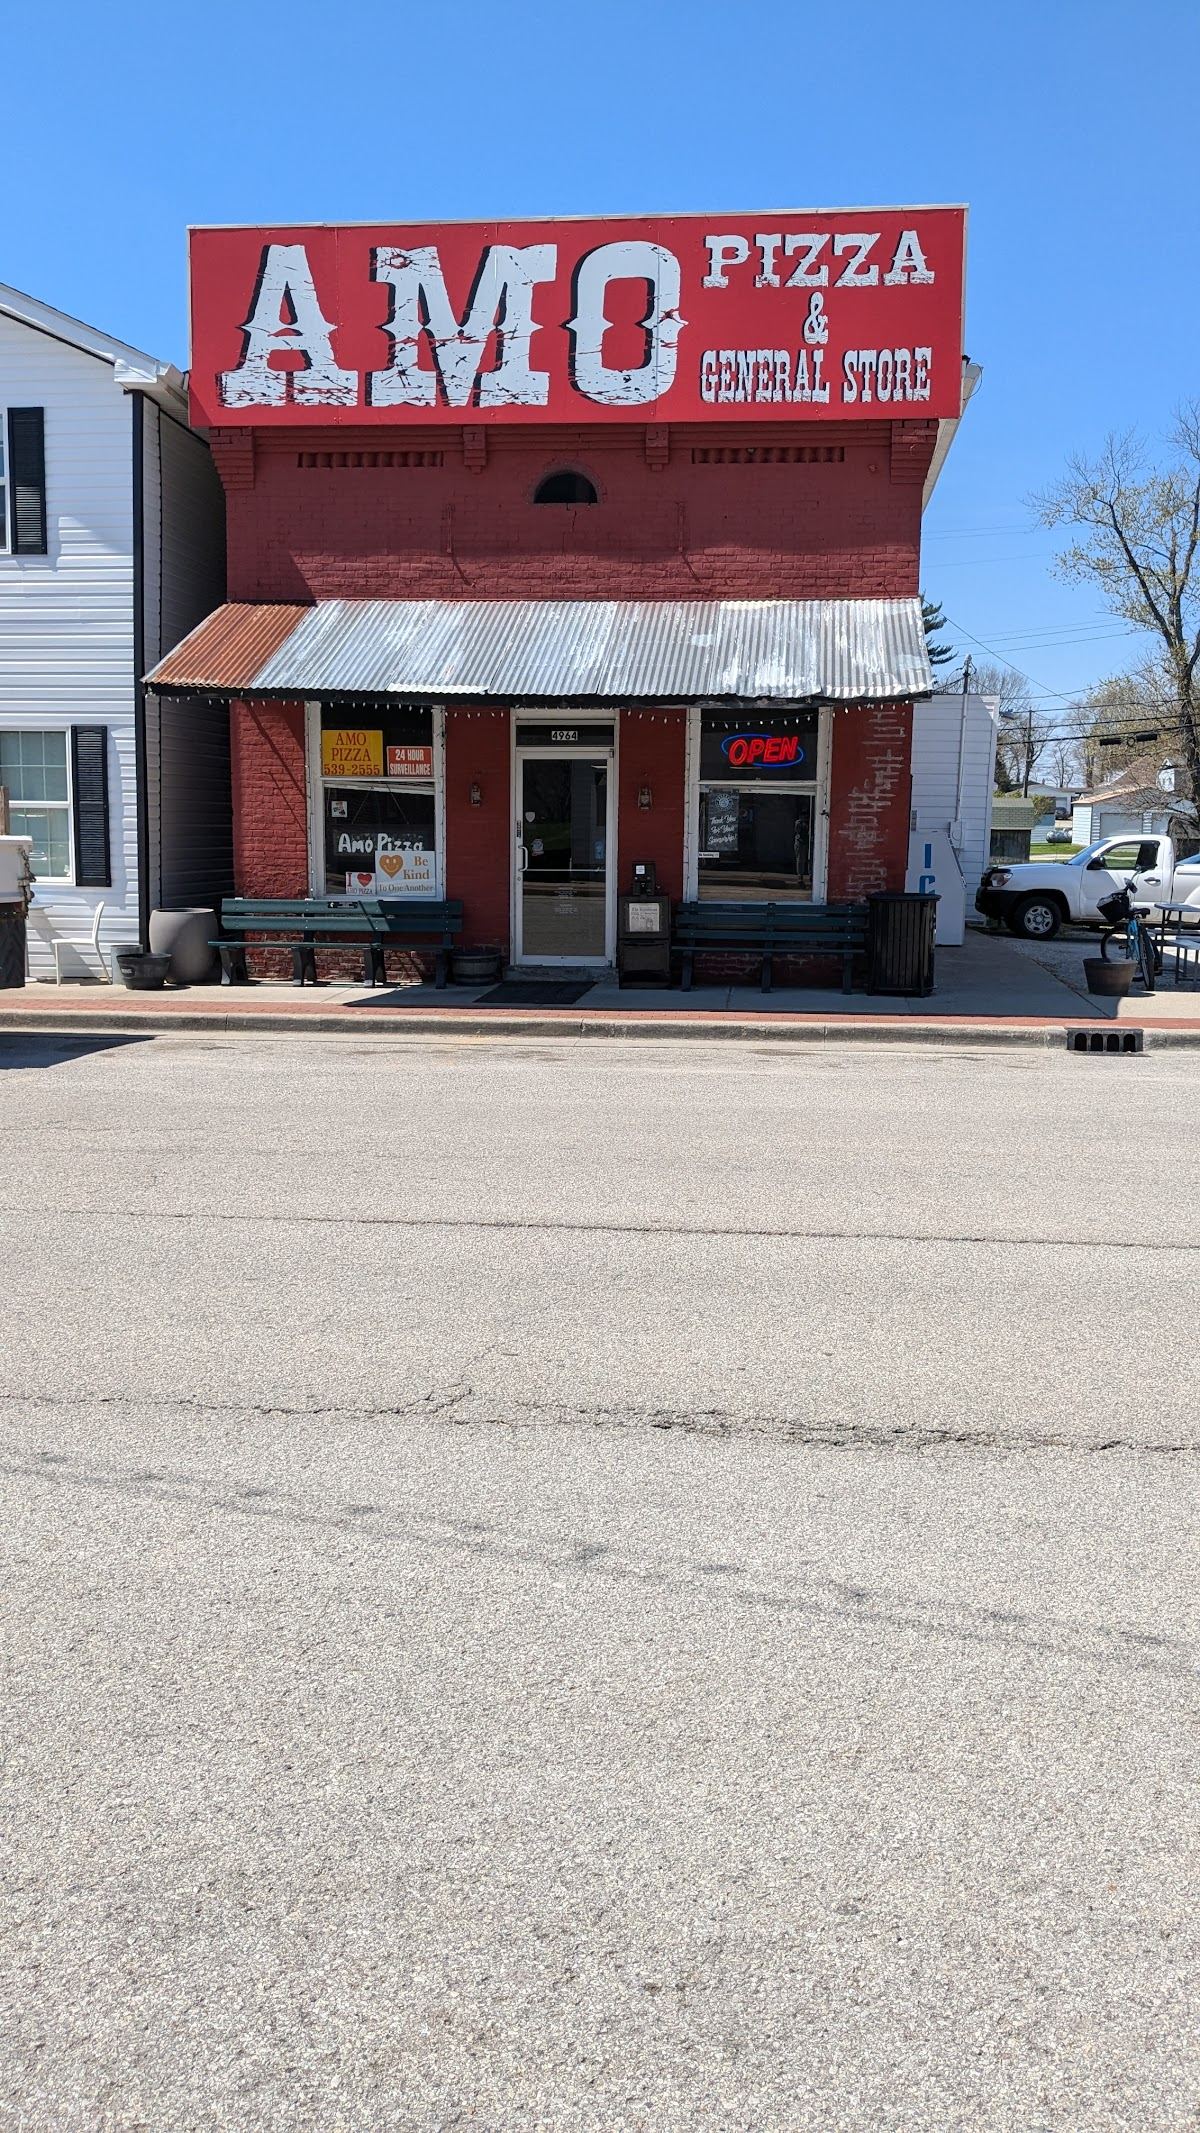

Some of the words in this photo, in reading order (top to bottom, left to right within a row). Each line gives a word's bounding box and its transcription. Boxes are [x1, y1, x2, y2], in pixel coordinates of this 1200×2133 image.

[703, 230, 936, 288] PIZZA
[217, 241, 689, 407] AMO
[802, 292, 830, 345] &
[701, 349, 830, 403] GENERAL
[843, 347, 932, 402] STORE
[335, 732, 367, 746] AMO
[552, 731, 578, 741] 4964
[331, 748, 372, 762] PIZZA
[395, 749, 405, 761] 24
[407, 749, 425, 761] HOUR
[729, 736, 798, 765] OPEN
[324, 764, 380, 776] 539-2555
[389, 763, 431, 776] SURVEILLANCE
[338, 833, 374, 853] Amo
[377, 833, 423, 851] Pizza
[414, 855, 429, 867] Be
[403, 869, 430, 880] Kind
[919, 844, 935, 894] IC
[347, 872, 353, 888] I
[379, 884, 388, 892] To
[405, 884, 433, 892] Another
